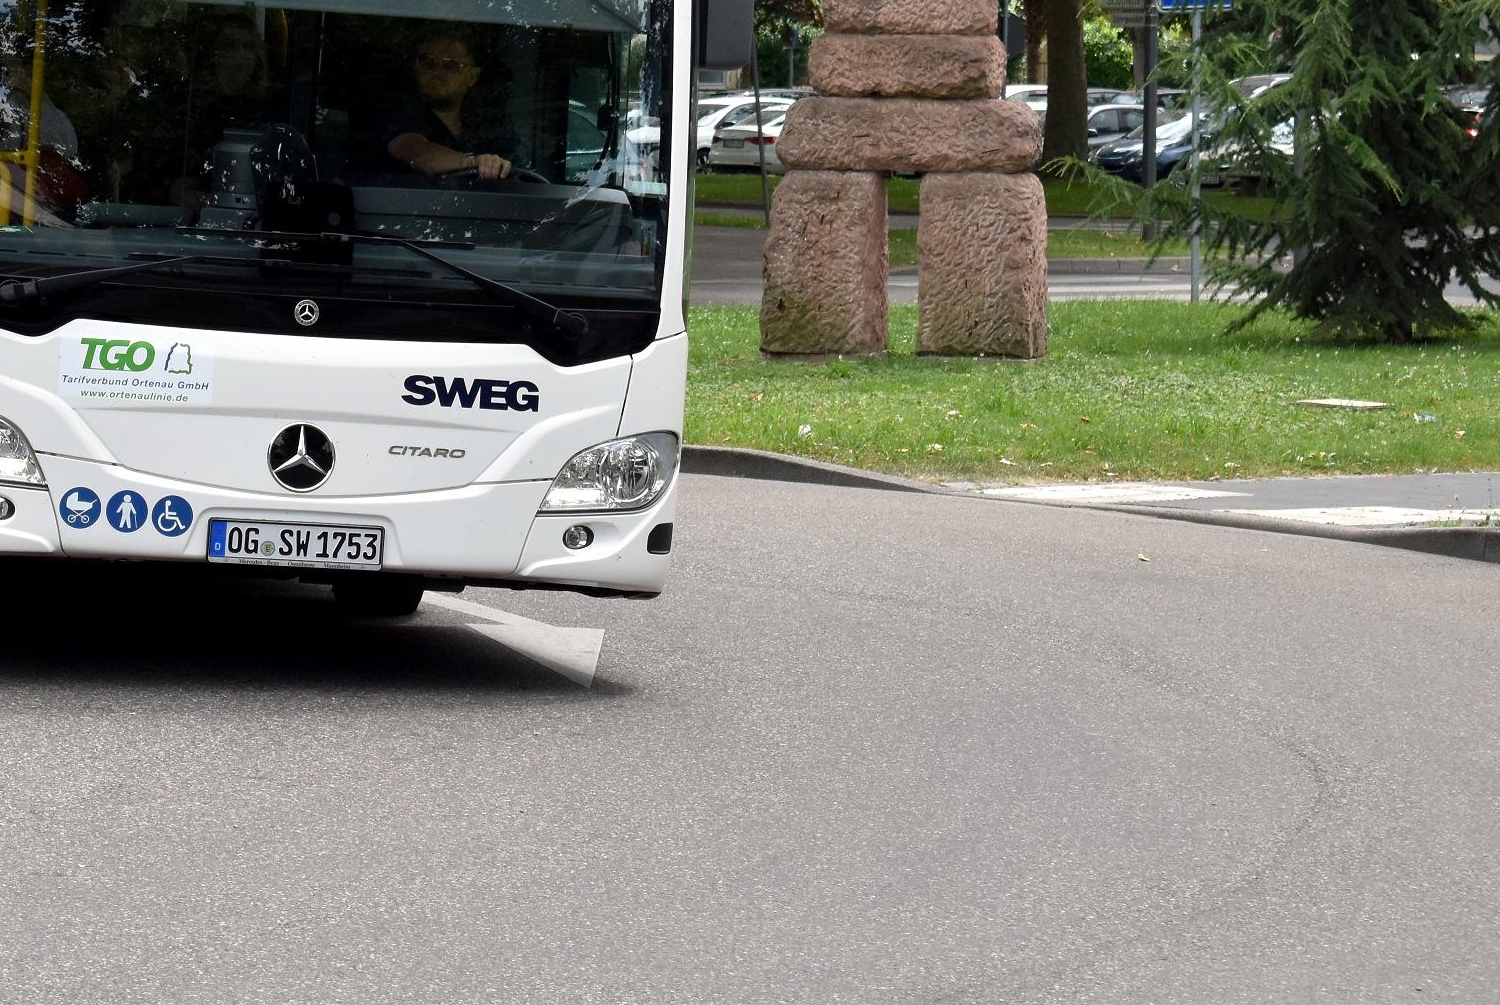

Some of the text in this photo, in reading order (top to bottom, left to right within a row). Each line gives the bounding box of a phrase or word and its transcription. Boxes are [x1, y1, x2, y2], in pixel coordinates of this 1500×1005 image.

[81, 338, 156, 372] TGO
[62, 375, 209, 390] Tarifverbund Ortenau GmbH
[401, 374, 540, 412] SWEG
[80, 389, 189, 403] www.ortenaulinie.de
[388, 445, 466, 459] CITARO
[227, 526, 260, 554] OG
[278, 529, 311, 558] SW
[315, 531, 378, 561] 1753
